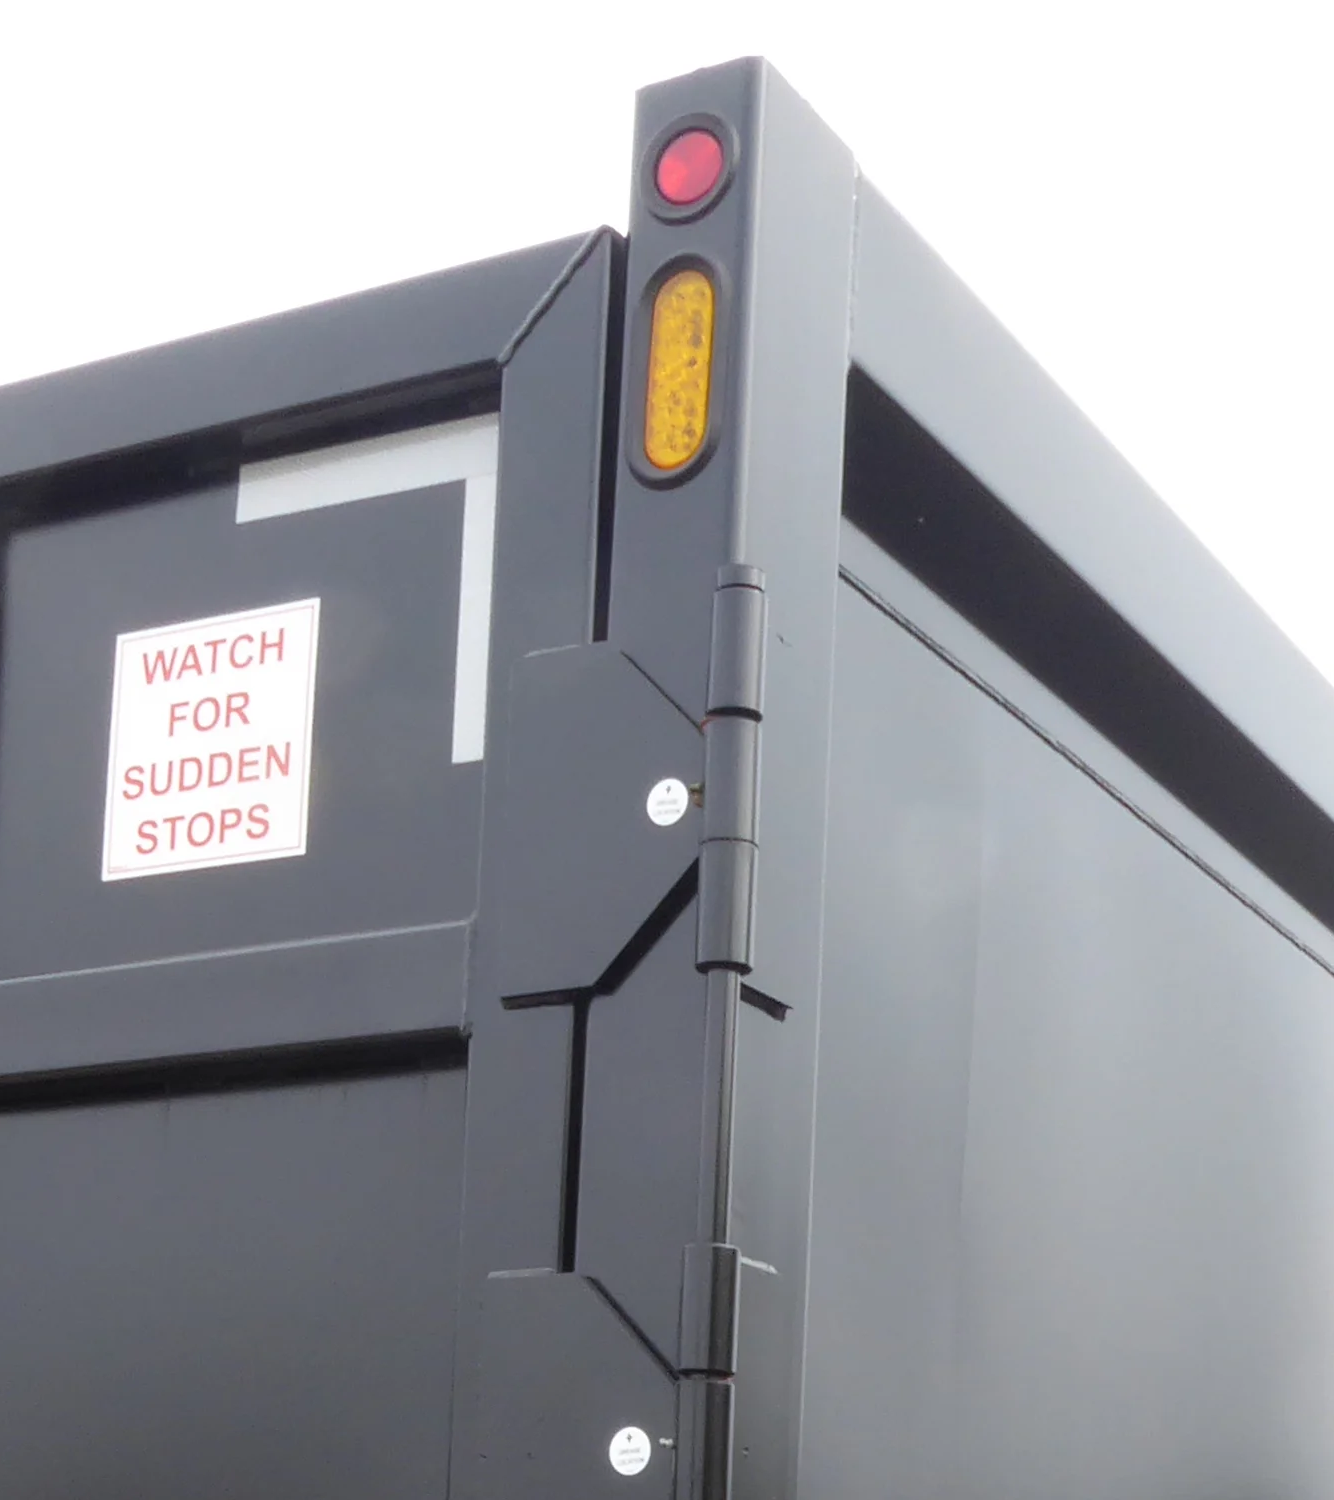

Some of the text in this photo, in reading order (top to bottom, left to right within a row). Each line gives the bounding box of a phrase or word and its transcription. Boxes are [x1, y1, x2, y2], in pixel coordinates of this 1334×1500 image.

[142, 628, 285, 685] WATCH
[168, 692, 251, 737] FOR
[122, 742, 291, 800] SUDDEN
[135, 803, 270, 855] STOPS
